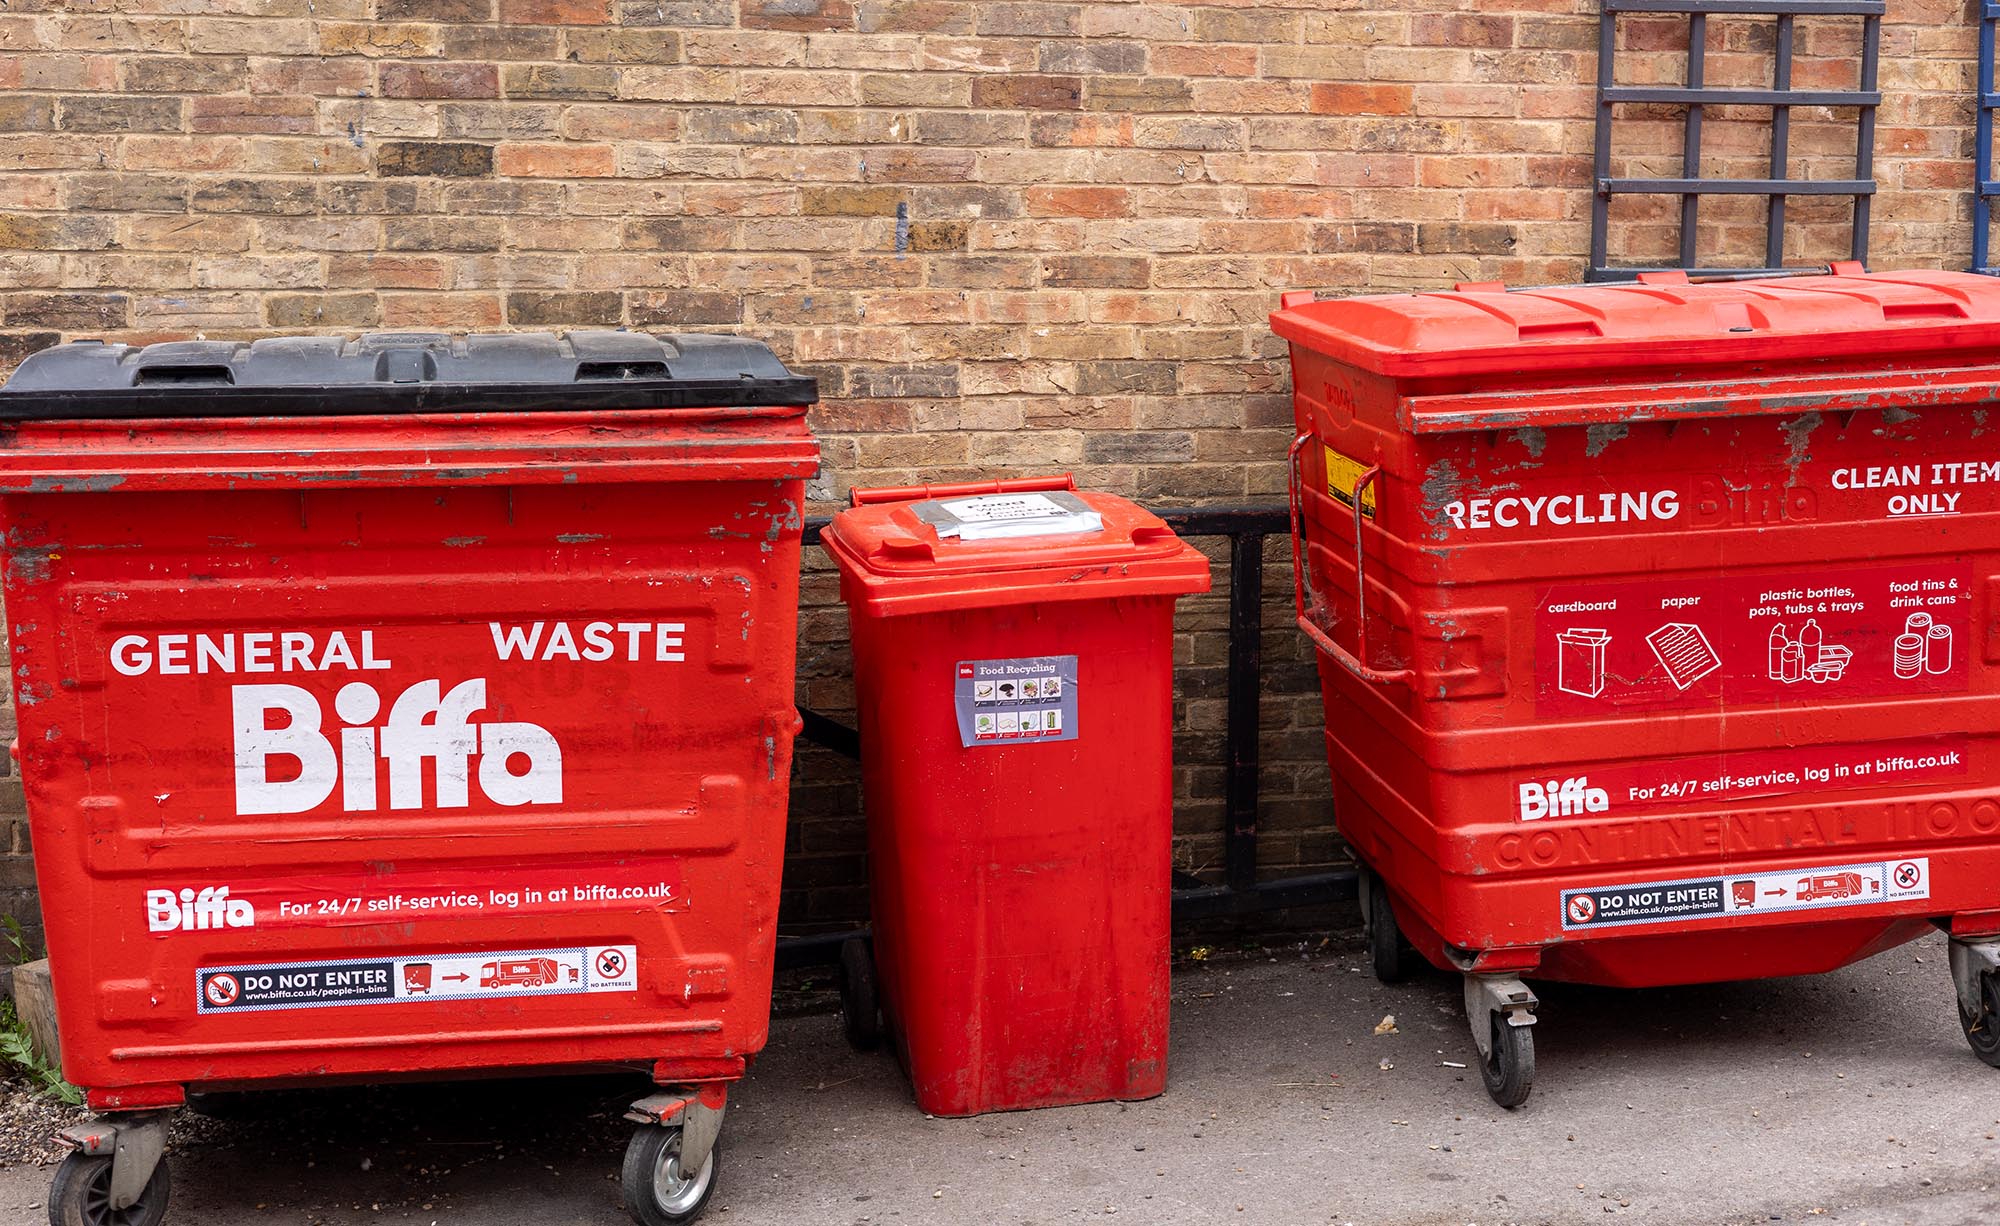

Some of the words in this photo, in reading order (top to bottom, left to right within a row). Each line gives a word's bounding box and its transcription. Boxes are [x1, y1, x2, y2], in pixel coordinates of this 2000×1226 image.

[1831, 464, 1921, 490] CLEAN
[1443, 489, 1680, 530] RECYCLING
[1887, 492, 1962, 514] ONLY
[1759, 588, 1803, 604] plastic
[1807, 586, 1855, 600] bottles,
[1889, 580, 1919, 593] food
[1922, 578, 1945, 591] tins
[1948, 578, 1958, 589] &
[1548, 599, 1617, 614] cardboard
[1661, 597, 1701, 610] paper
[1749, 605, 1781, 619] pots,
[1785, 602, 1813, 616] tubs
[1817, 602, 1827, 614] &
[1831, 601, 1864, 614] trays
[1890, 594, 1923, 608] drink
[1926, 594, 1956, 605] cans
[110, 630, 392, 676] GENERAL
[489, 621, 686, 662] WASTE
[980, 667, 1005, 675] Food
[1006, 664, 1056, 675] Recycling
[231, 678, 563, 815] Biffa
[1629, 787, 1656, 801] For
[1660, 781, 1697, 797] 24/7
[1702, 770, 1800, 792] self-service,
[1804, 767, 1830, 782] log
[1834, 763, 1849, 777] in
[1854, 761, 1871, 775] at
[1876, 751, 1960, 773] biffa.co.uk
[1519, 777, 1609, 821] Biffa
[1493, 806, 1857, 869] CONTINENTAL
[147, 886, 255, 932] Biffa
[280, 900, 312, 916] For
[318, 898, 362, 916] 24/7
[368, 891, 484, 912] self-service,
[489, 890, 519, 907] log
[525, 887, 542, 903] in
[547, 887, 568, 902] at
[574, 882, 671, 901] biffa.co.uk
[1600, 896, 1623, 910] DO
[1628, 892, 1661, 906] NOT
[1667, 887, 1718, 903] ENTER
[1601, 900, 1719, 918] www.biffa.co.uk/people-in-bins
[245, 975, 273, 991] DO
[279, 973, 319, 988] NOT
[326, 969, 387, 986] ENTER
[245, 984, 388, 1001] www.biffa.co.uk/people-in-bins
